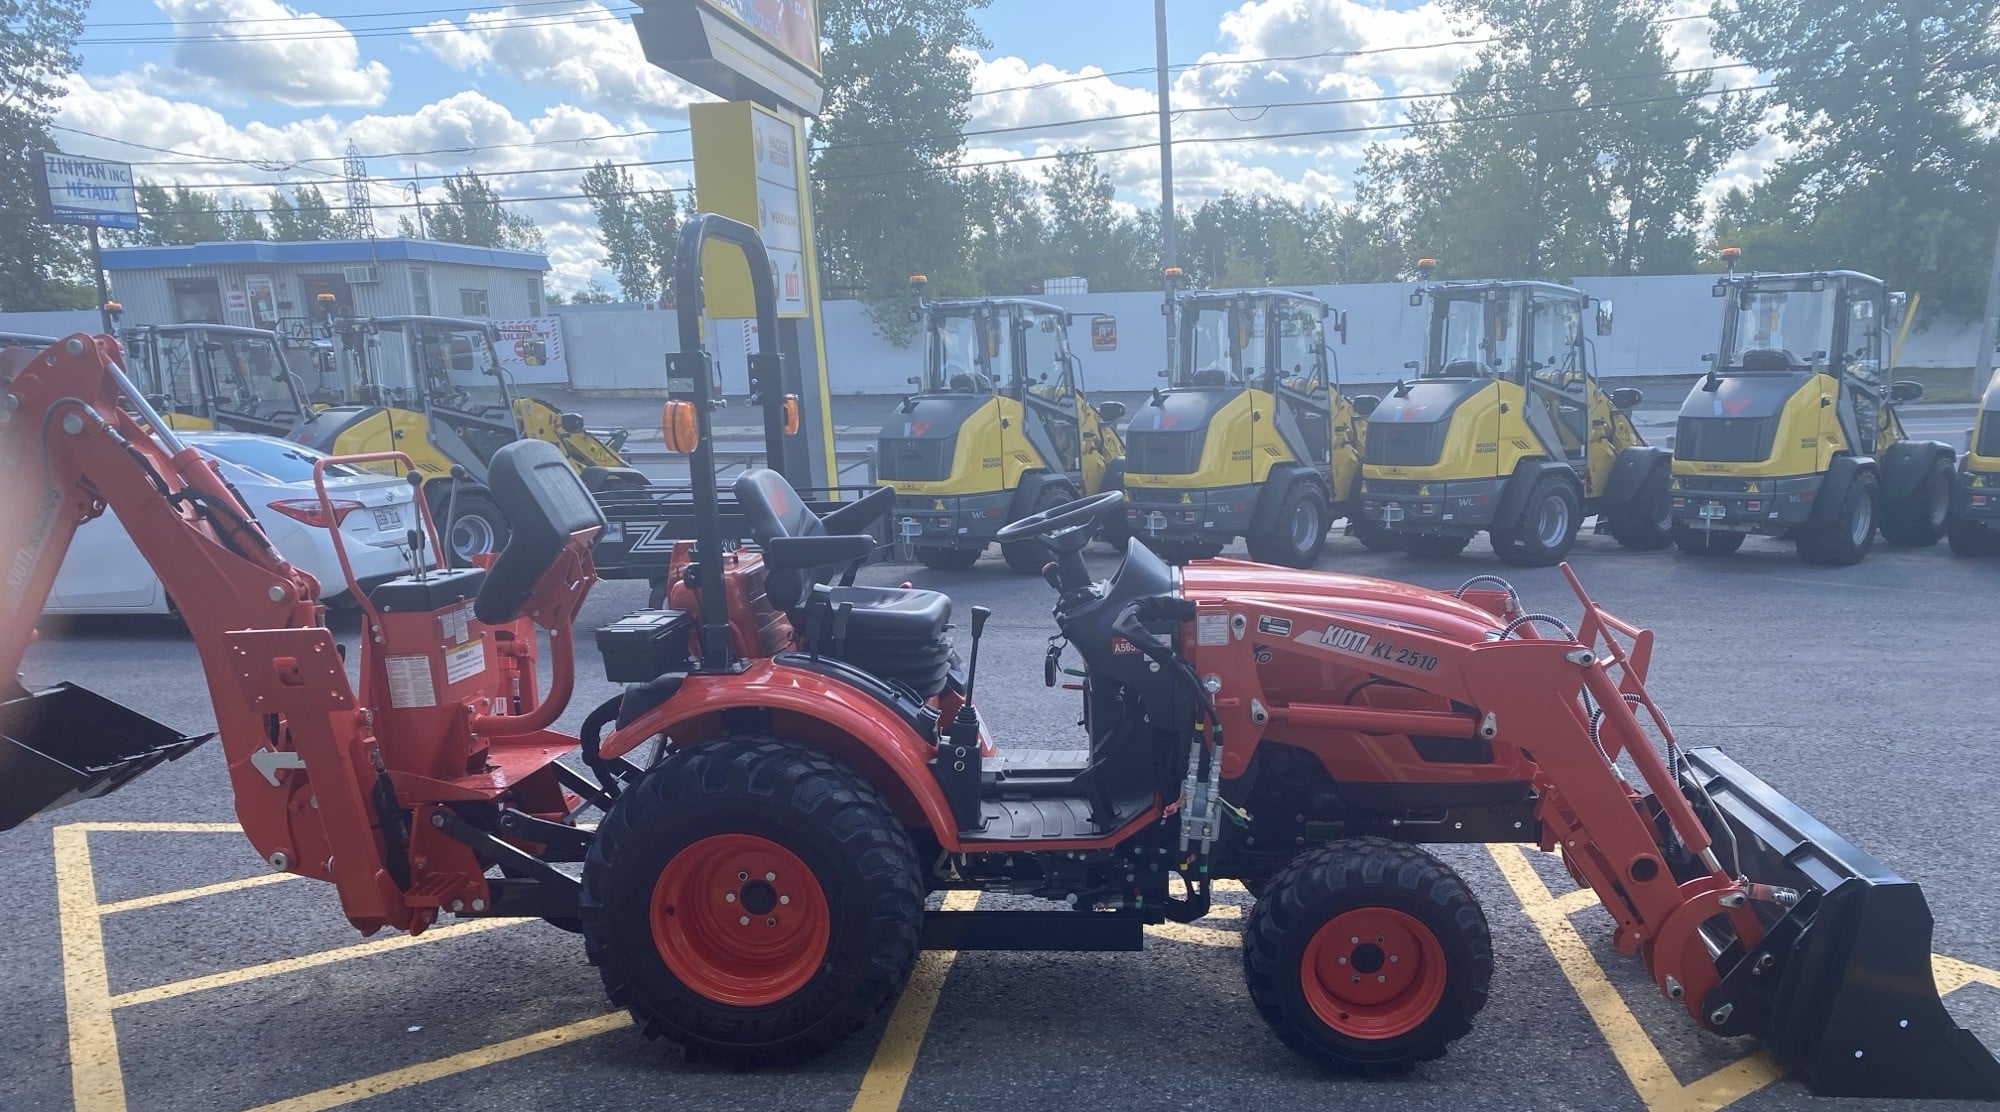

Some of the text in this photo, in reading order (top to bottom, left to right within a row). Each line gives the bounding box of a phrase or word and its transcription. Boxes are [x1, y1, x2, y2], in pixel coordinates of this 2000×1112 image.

[46, 156, 130, 183] ZINMAN INC.
[65, 178, 120, 202] MÉTAUX
[1114, 642, 1142, 654] A565
[1319, 624, 1372, 654] KIOTI
[1371, 641, 1393, 660] KL
[1395, 648, 1439, 671] 2510
